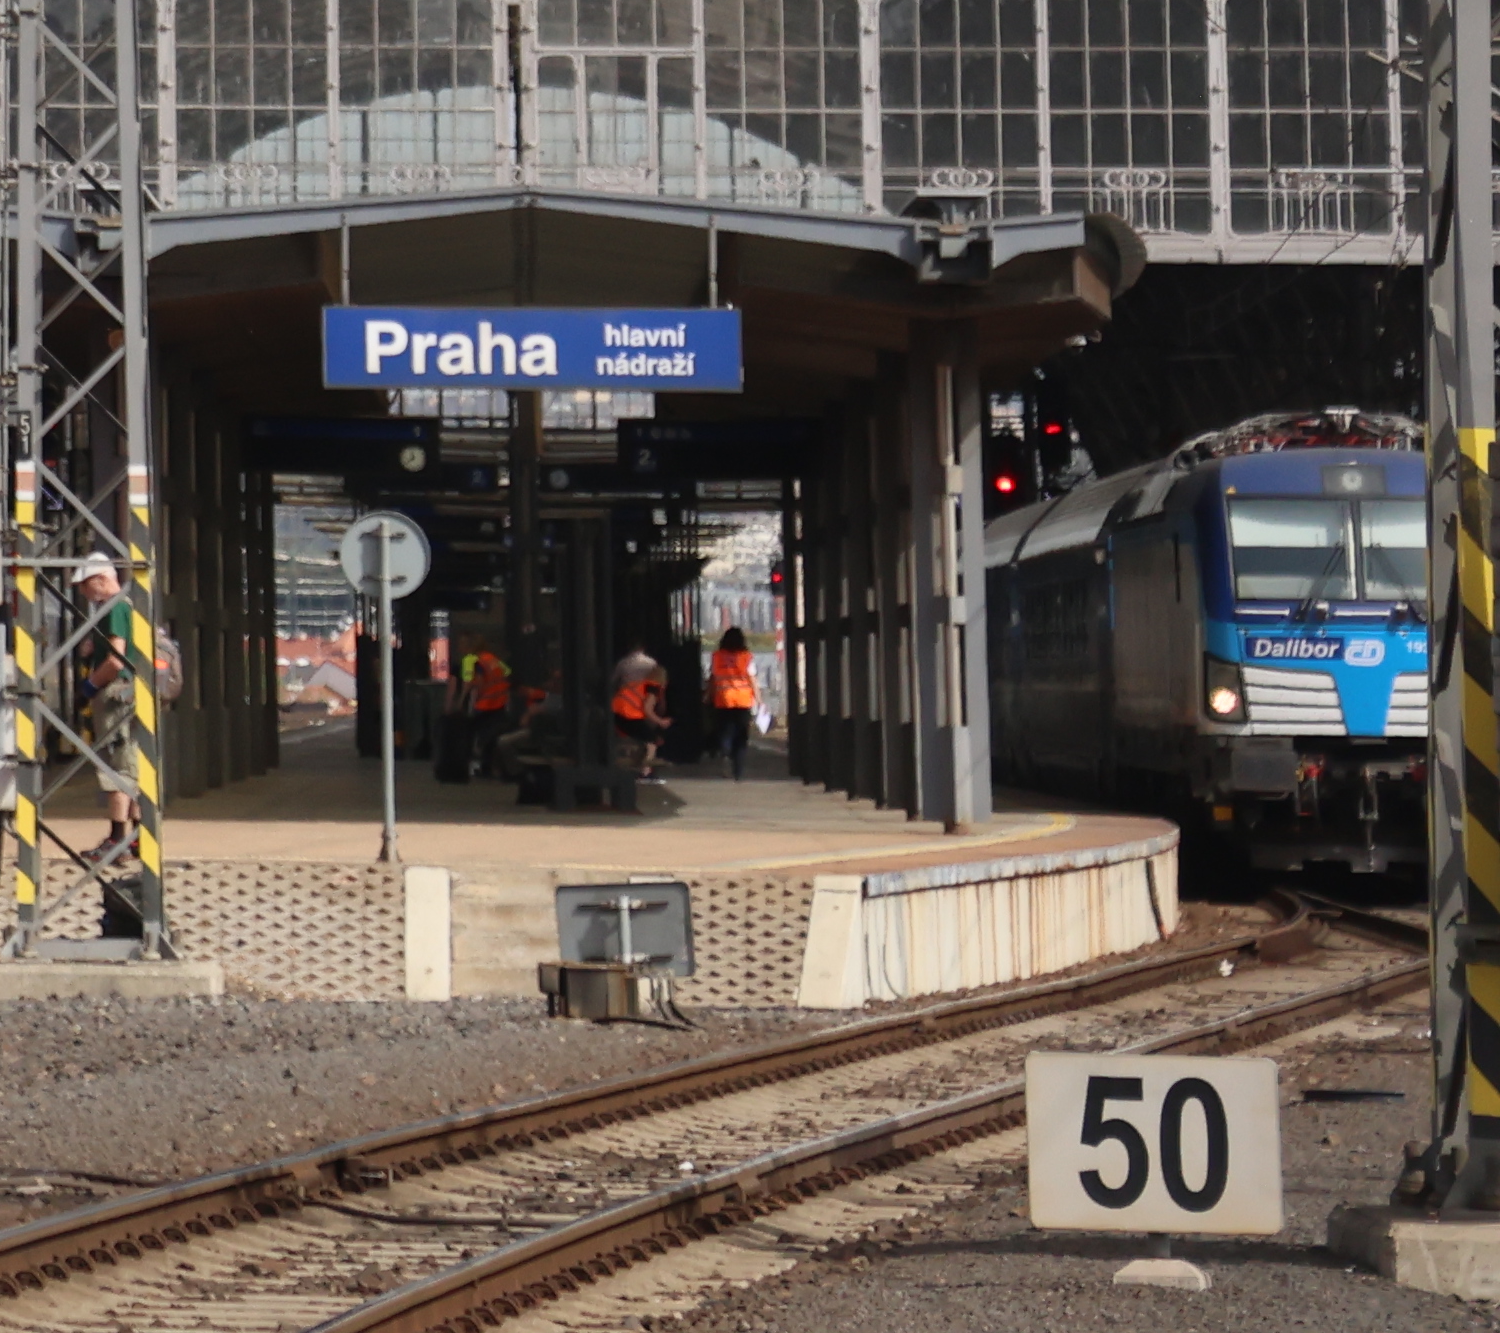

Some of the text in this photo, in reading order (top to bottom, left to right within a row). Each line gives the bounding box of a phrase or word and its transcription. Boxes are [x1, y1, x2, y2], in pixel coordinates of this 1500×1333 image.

[365, 320, 558, 377] Praha
[604, 323, 687, 348] hlavní
[596, 352, 696, 377] nádraží
[20, 415, 31, 455] 51
[1254, 639, 1340, 659] Dalibor
[1079, 1076, 1229, 1213] 50
